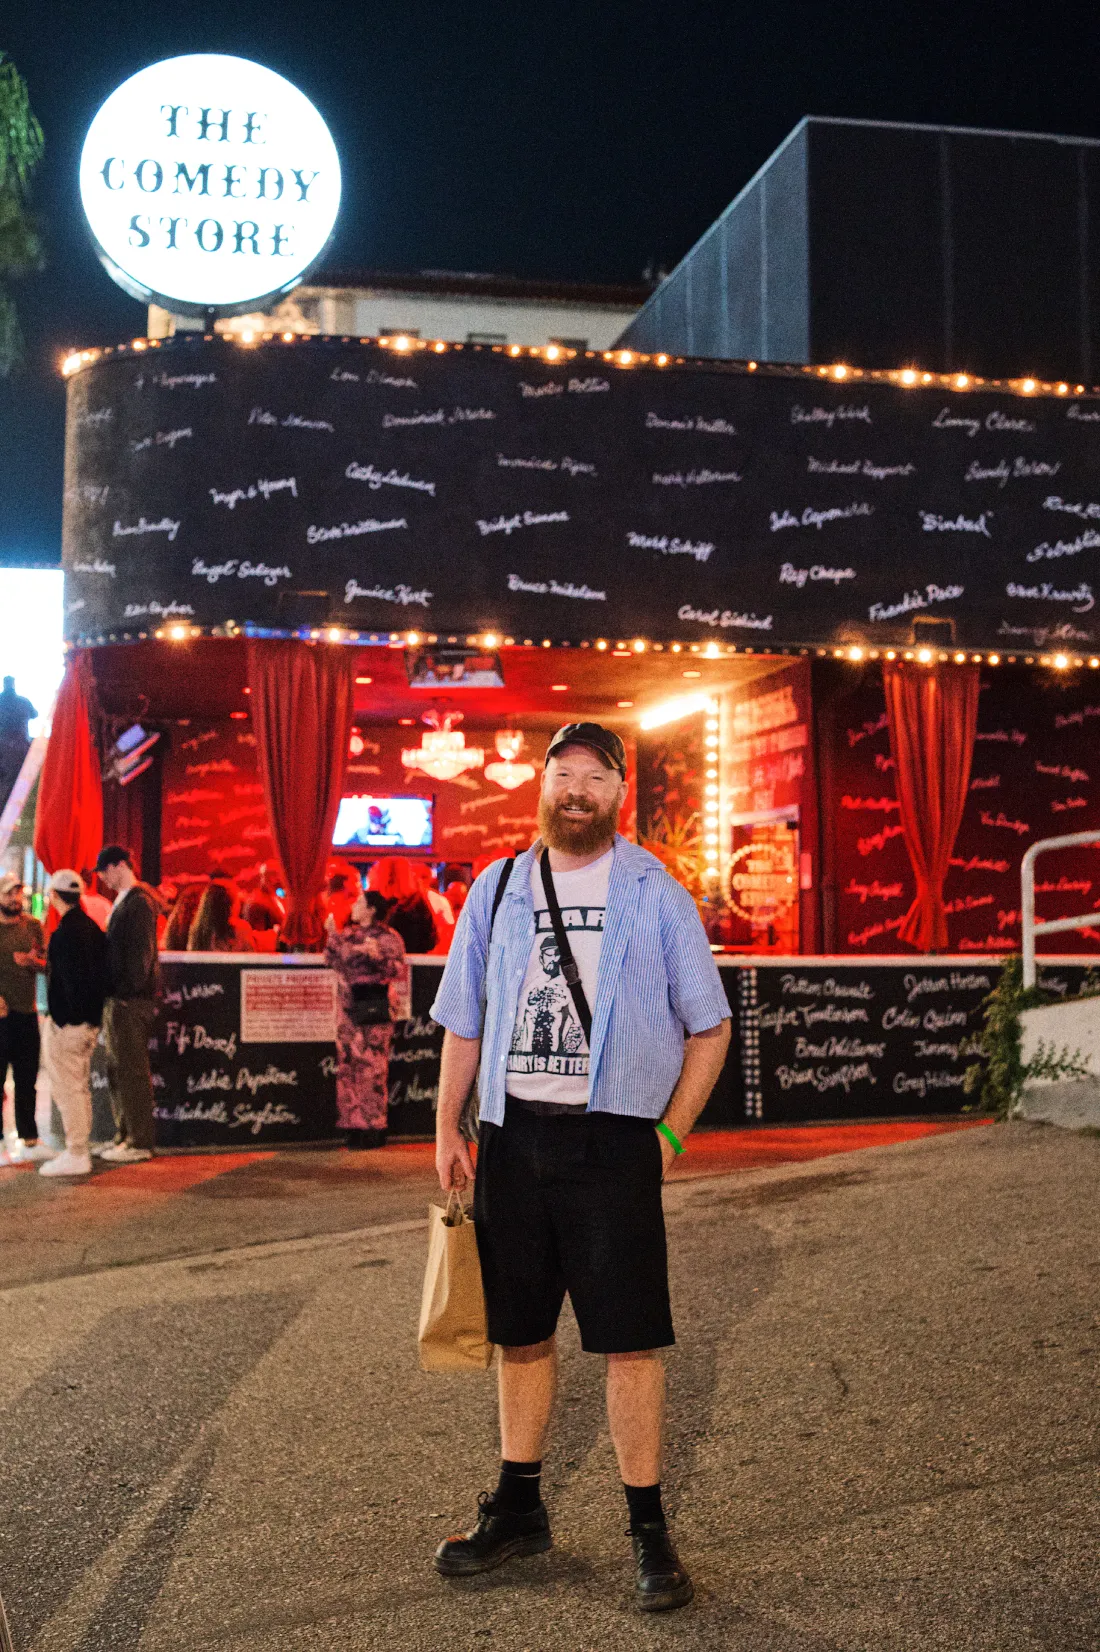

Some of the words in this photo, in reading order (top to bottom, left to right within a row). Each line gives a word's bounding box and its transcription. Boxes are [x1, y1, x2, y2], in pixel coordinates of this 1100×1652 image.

[160, 104, 269, 145] THE
[99, 156, 321, 203] COMEDY
[128, 213, 296, 257] STORE
